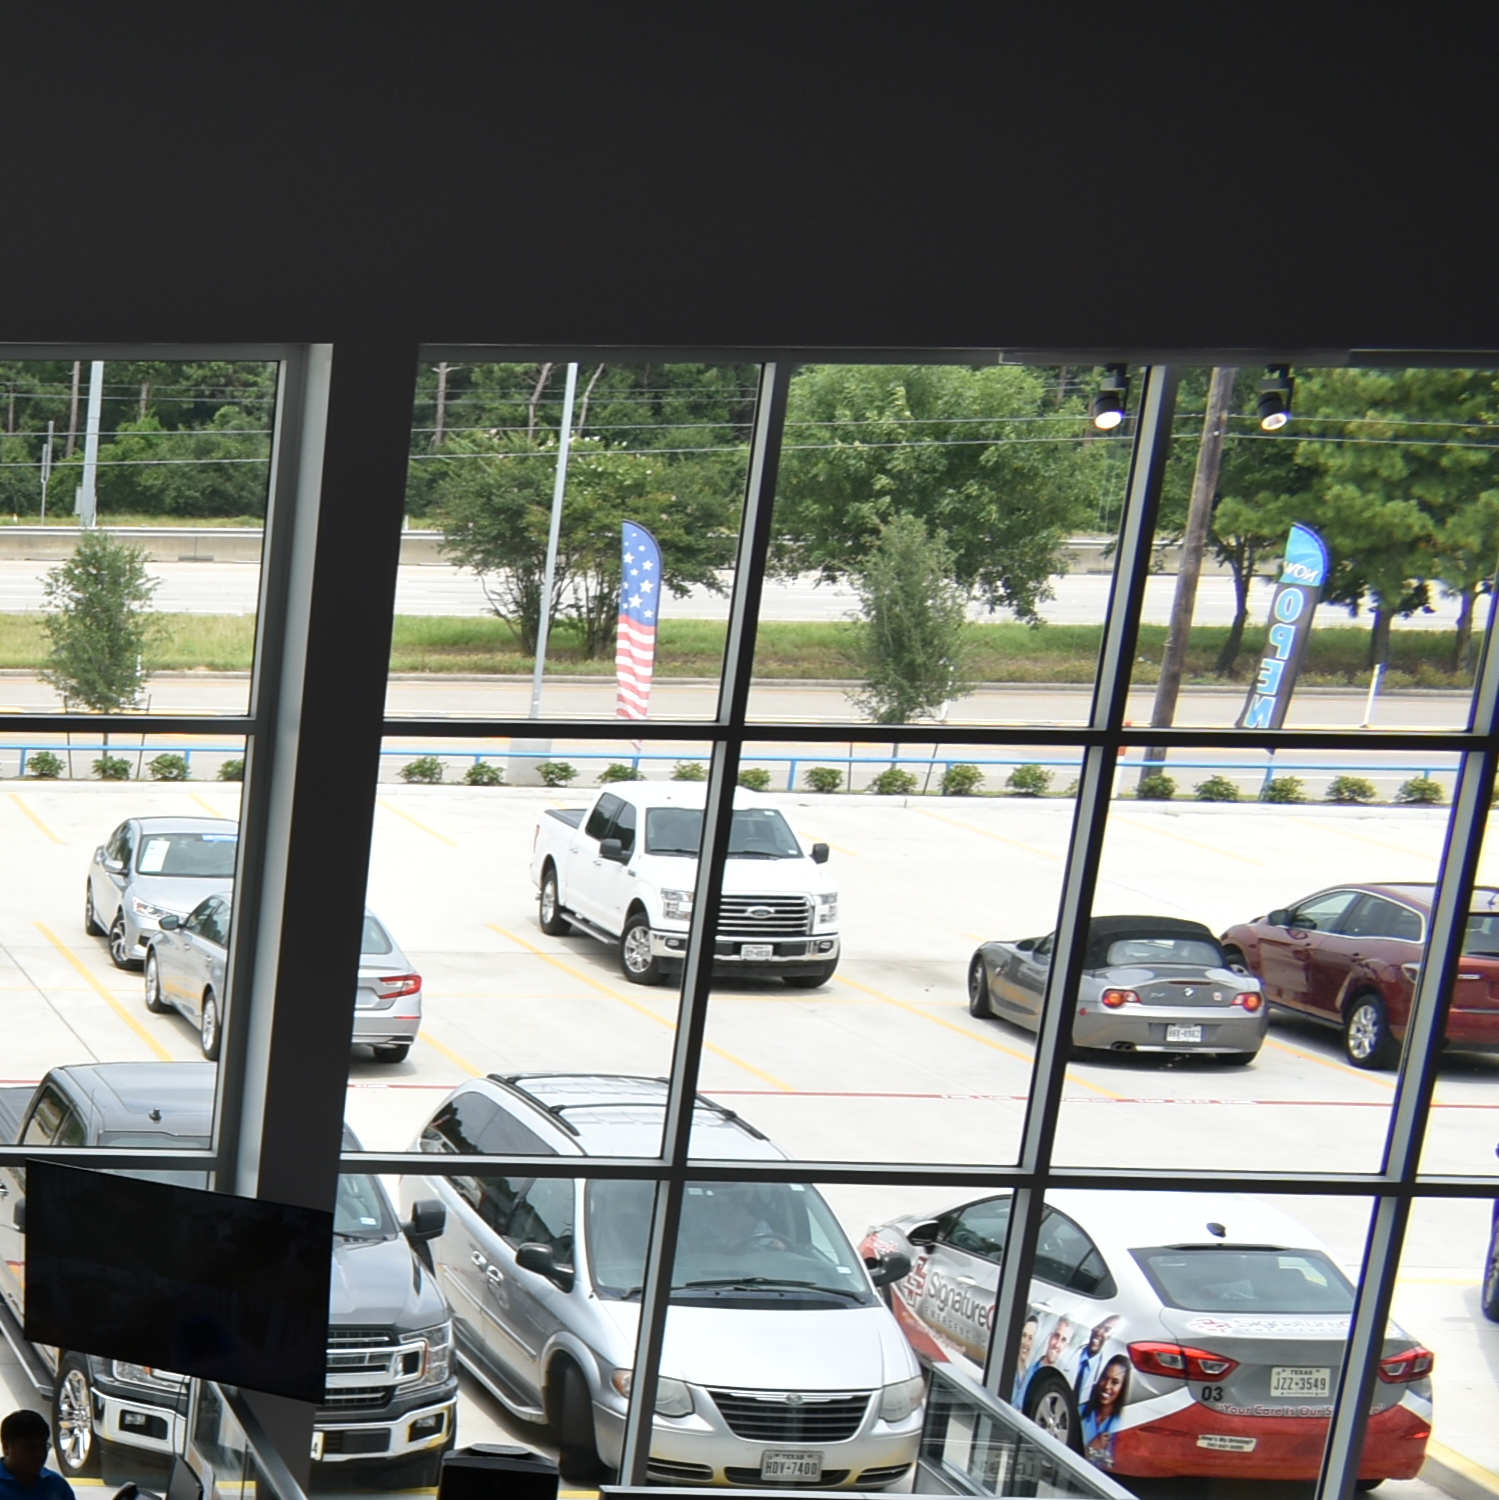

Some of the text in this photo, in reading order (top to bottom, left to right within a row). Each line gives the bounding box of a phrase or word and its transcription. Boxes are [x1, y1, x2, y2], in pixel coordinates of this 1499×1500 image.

[1273, 1377, 1327, 1391] JZZ-3549
[1201, 1386, 1224, 1401] 03
[1254, 1405, 1282, 1416] Care
[1298, 1405, 1322, 1416] Our
